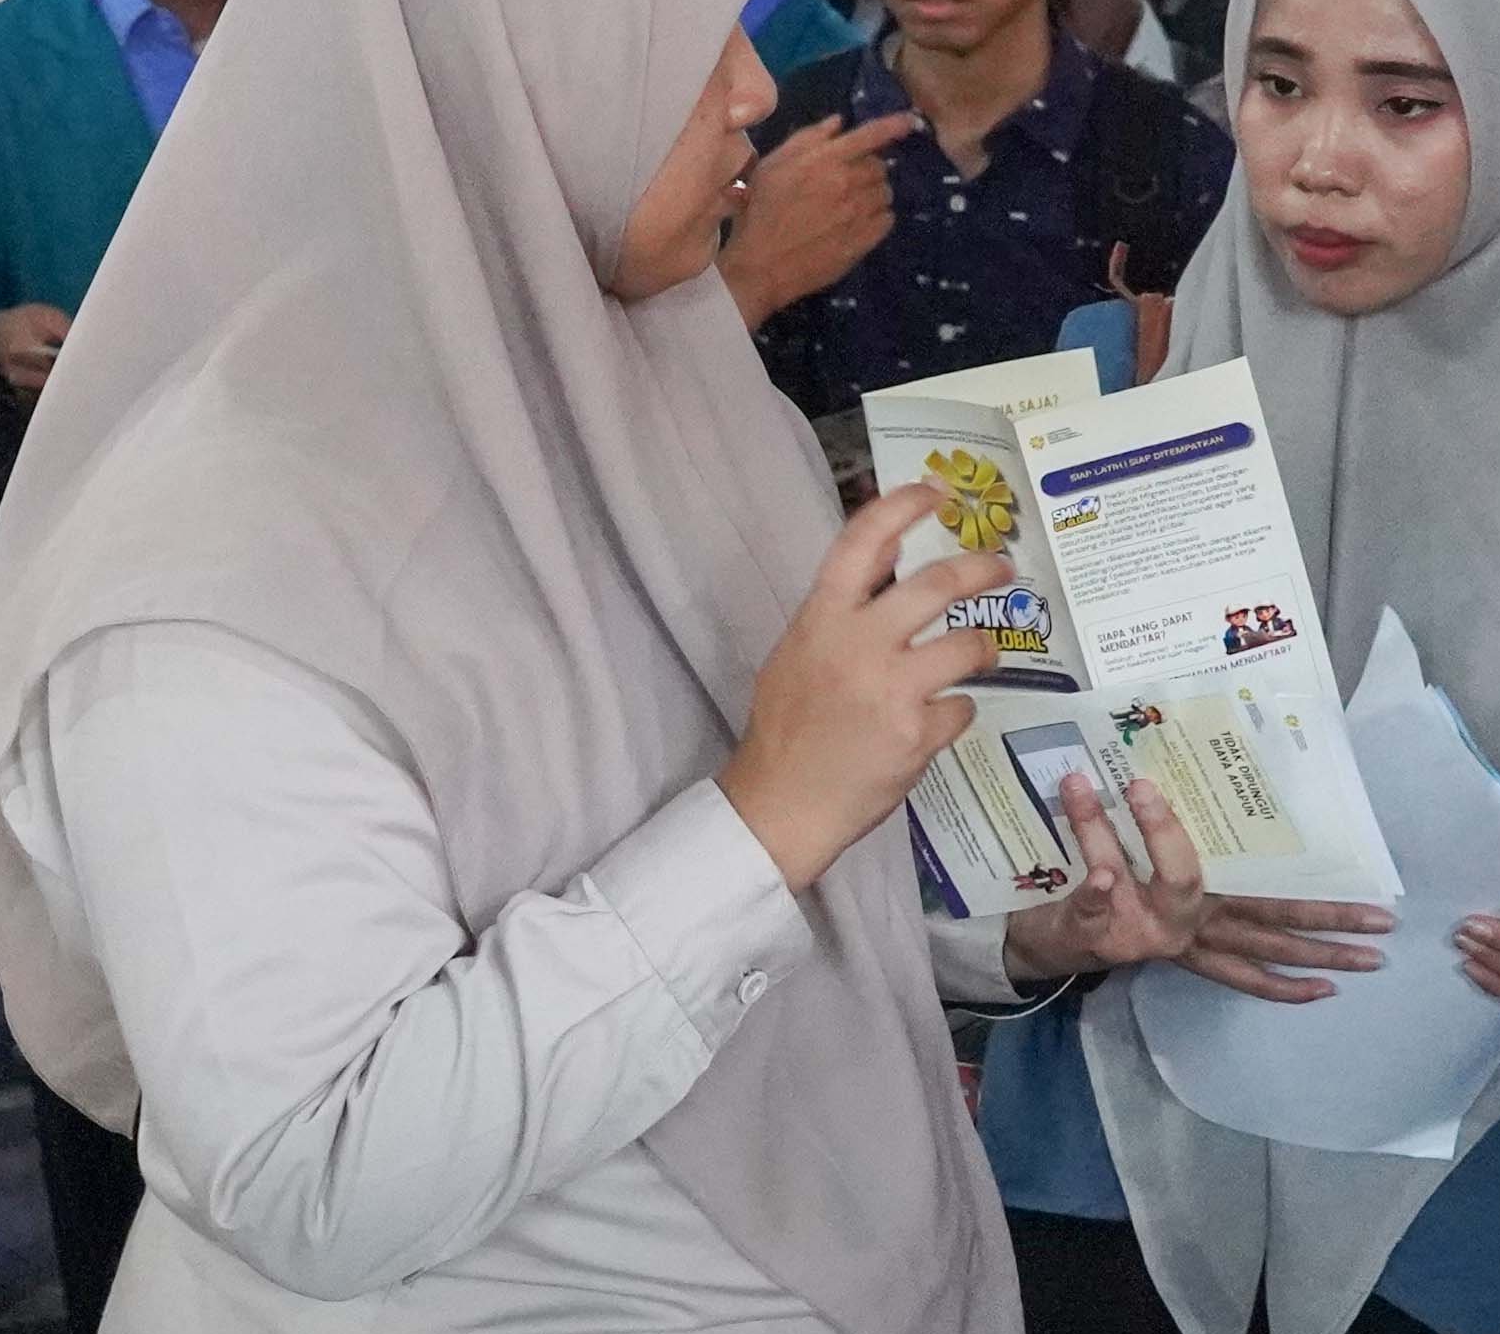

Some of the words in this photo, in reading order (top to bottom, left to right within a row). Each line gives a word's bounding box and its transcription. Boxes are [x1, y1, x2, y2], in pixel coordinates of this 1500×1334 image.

[1019, 394, 1059, 413] SAJA?
[1153, 434, 1224, 460] DITEMPATKAN
[1052, 503, 1080, 523] SMK
[948, 596, 1008, 629] SMK
[1097, 628, 1125, 643] SIAPA
[1129, 620, 1159, 635] YANG
[1161, 611, 1194, 627] DAPAT
[1100, 629, 1166, 654] MENDAFTAR?
[1098, 747, 1129, 801] SEKARAN
[1208, 736, 1232, 770] BIAYA
[1225, 771, 1257, 819] APAPUN
[1219, 729, 1244, 764] TIDAK
[1237, 763, 1275, 823] DIPUNGUT
